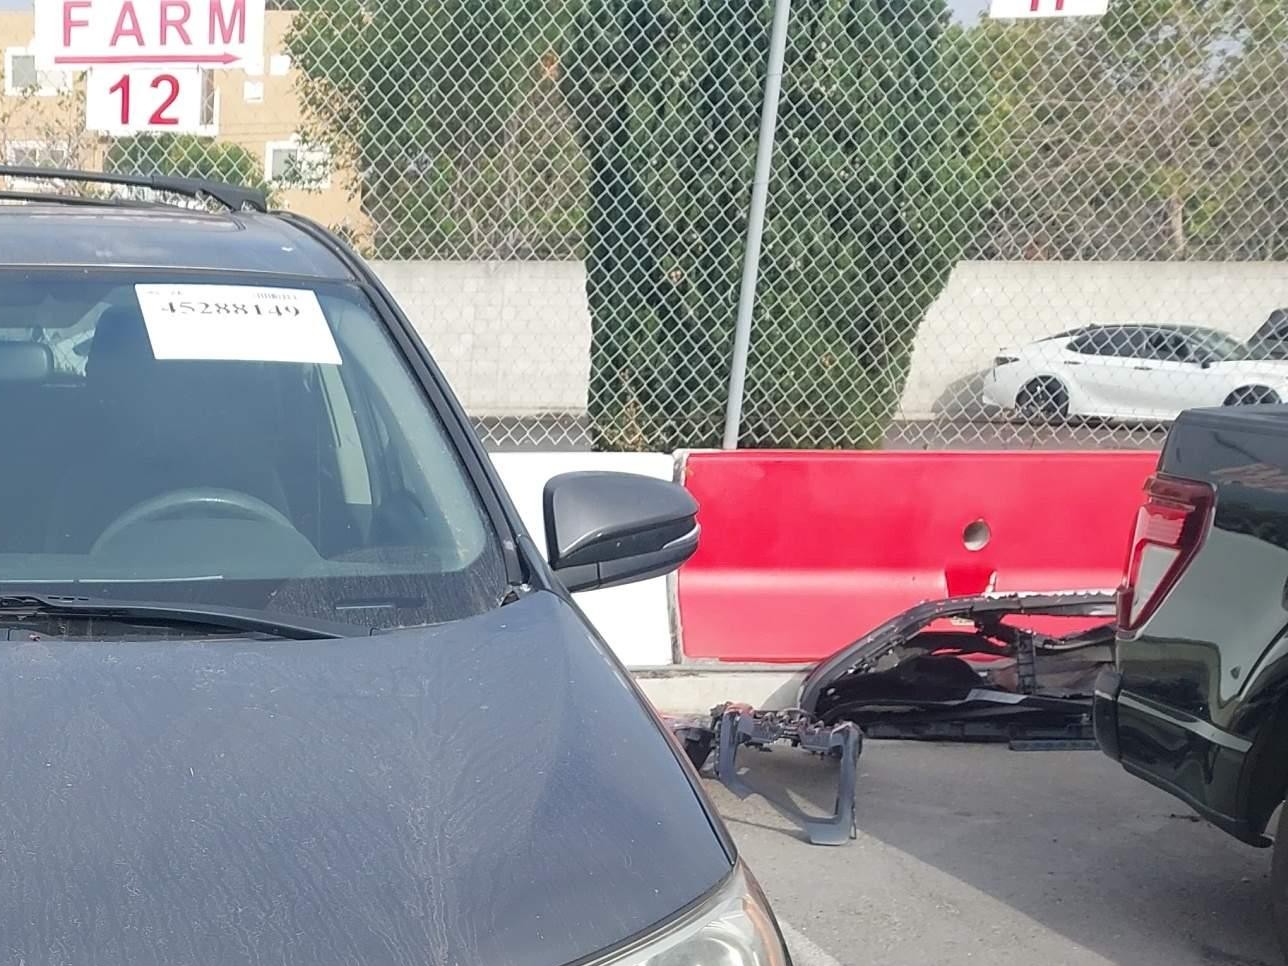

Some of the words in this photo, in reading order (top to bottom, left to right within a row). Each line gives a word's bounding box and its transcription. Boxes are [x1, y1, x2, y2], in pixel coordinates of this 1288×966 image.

[62, 0, 246, 46] FARM
[109, 74, 180, 126] 12
[160, 300, 301, 318] 45288149
